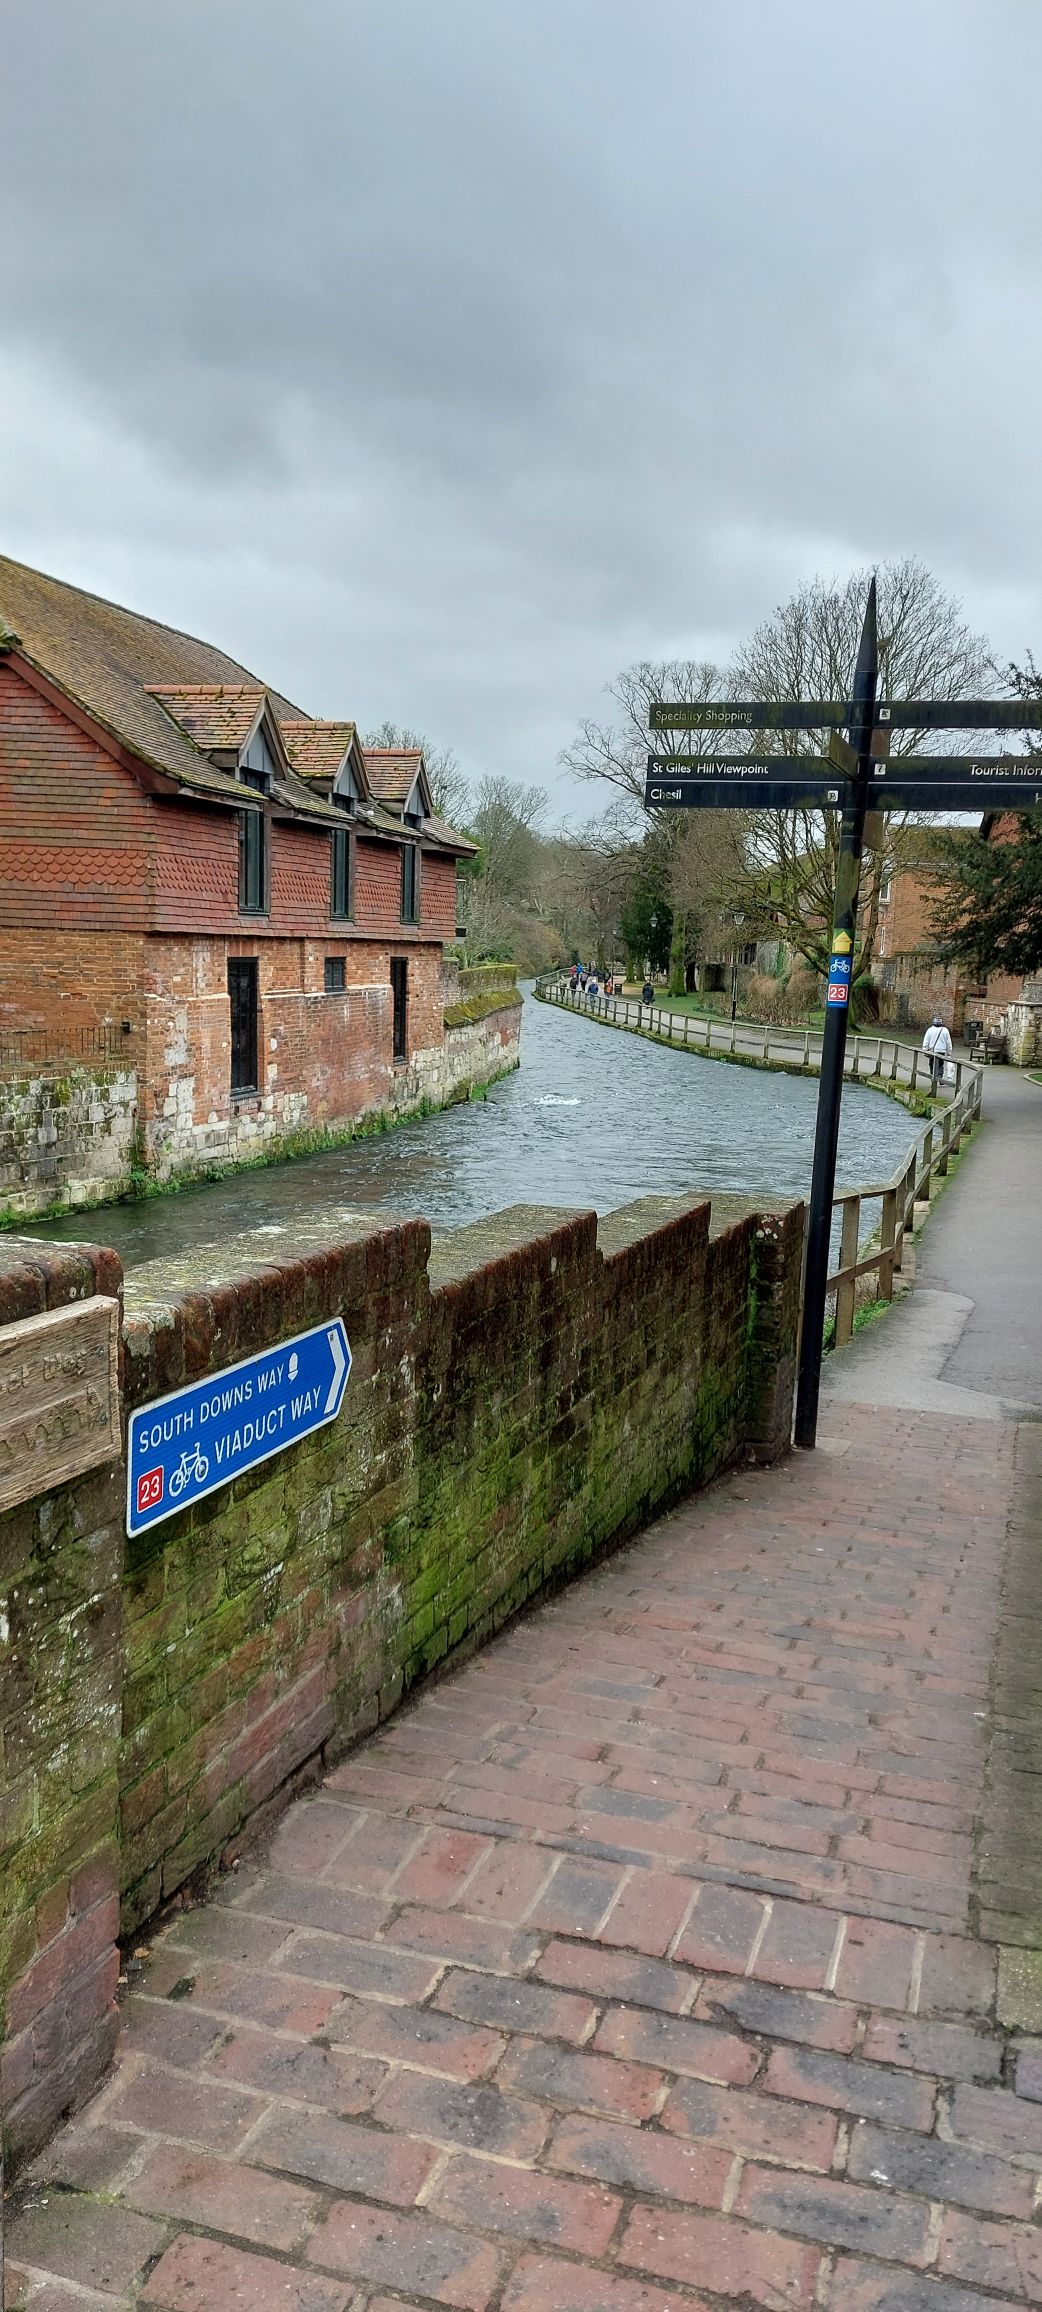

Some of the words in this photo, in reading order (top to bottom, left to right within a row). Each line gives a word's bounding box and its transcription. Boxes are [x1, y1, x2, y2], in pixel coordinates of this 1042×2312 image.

[705, 710, 753, 723] Shopping
[652, 762, 663, 773] St
[666, 762, 694, 773] Giles'
[697, 762, 715, 773] Hill
[715, 763, 769, 777] Viewpoint
[969, 764, 1010, 776] Tourist
[650, 788, 682, 800] Chesil
[830, 987, 846, 998] 23
[139, 1409, 194, 1454] SOUTH
[200, 1382, 253, 1424] DOWNS
[257, 1363, 285, 1394] WAY
[140, 1475, 160, 1504] 23
[214, 1404, 287, 1464] VIADUCT
[290, 1385, 322, 1421] WAY
